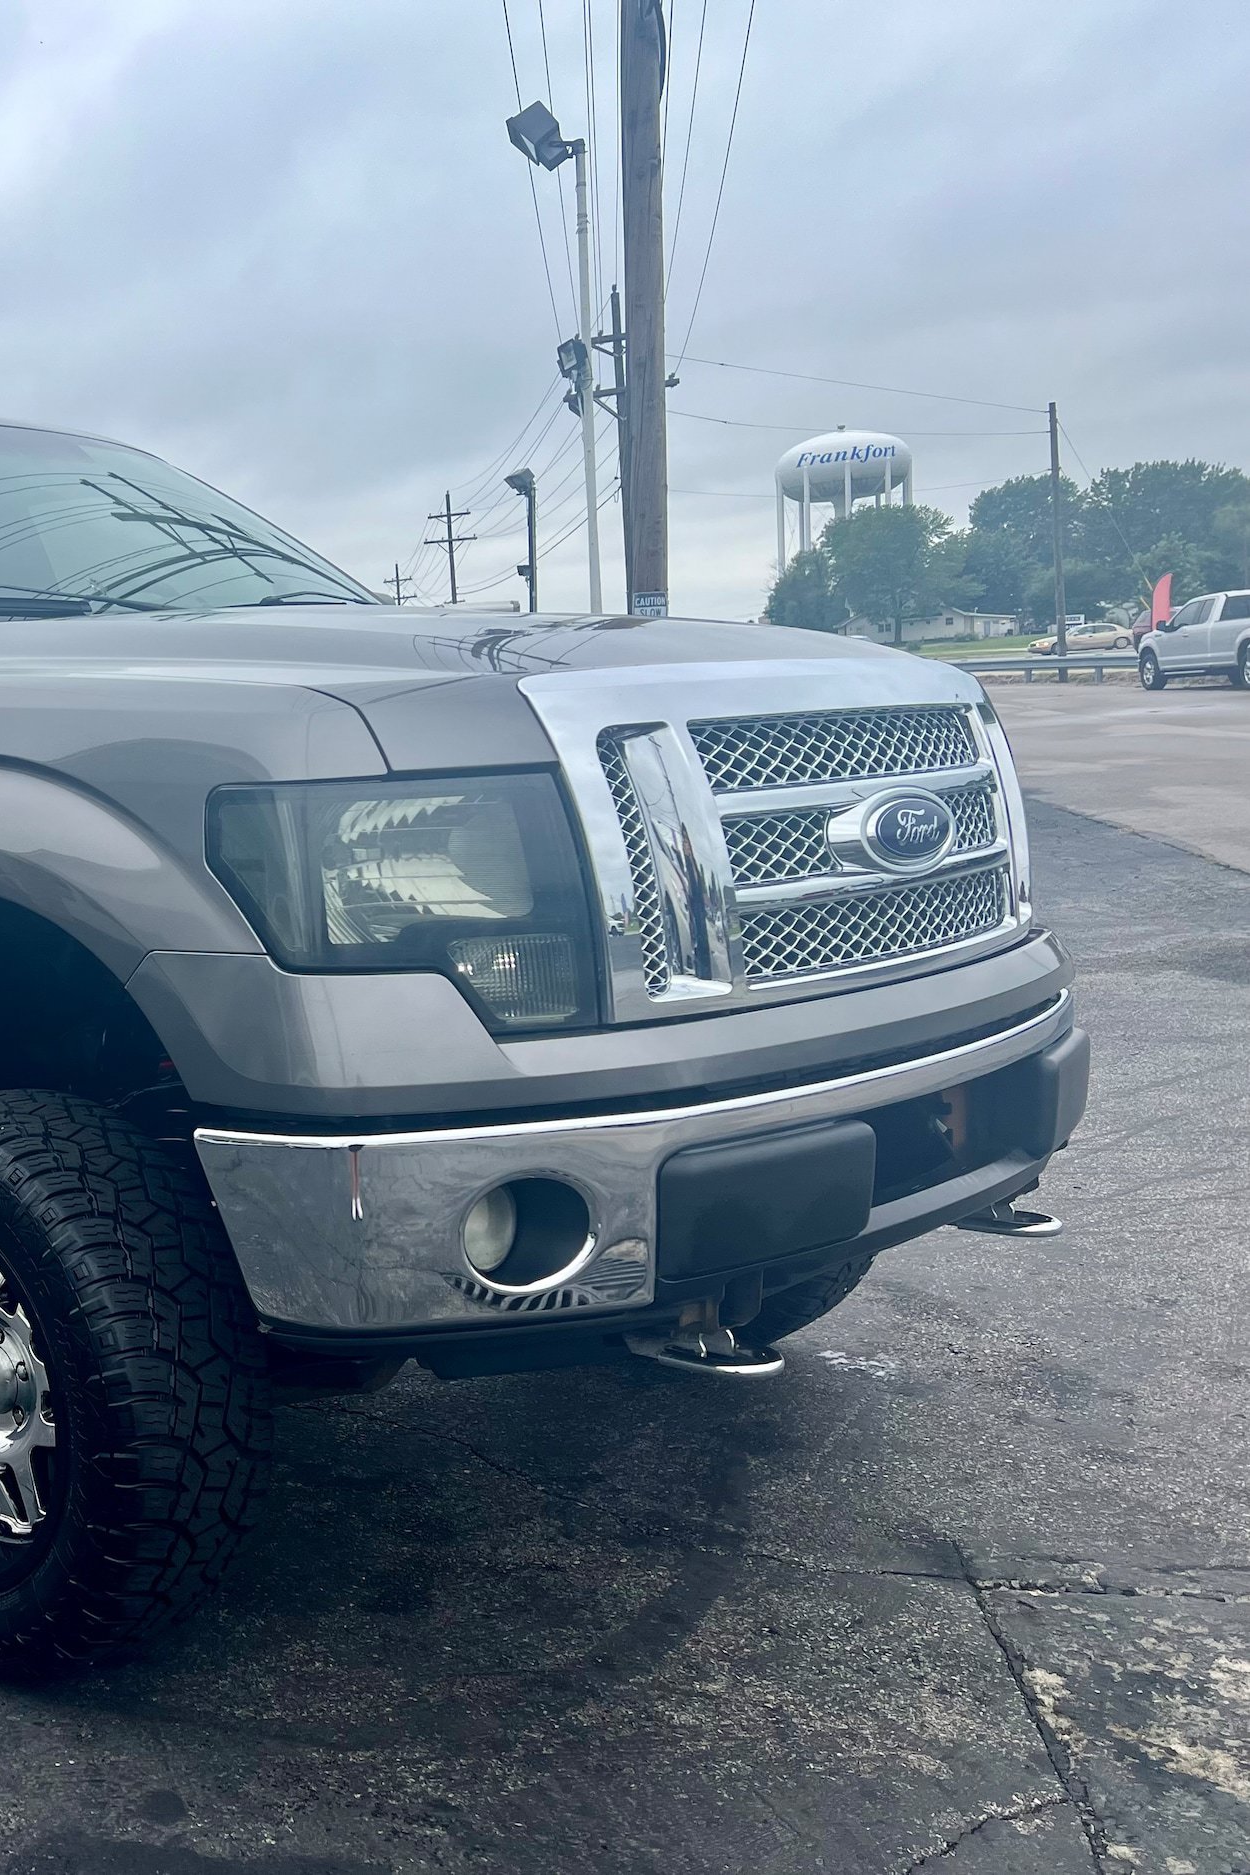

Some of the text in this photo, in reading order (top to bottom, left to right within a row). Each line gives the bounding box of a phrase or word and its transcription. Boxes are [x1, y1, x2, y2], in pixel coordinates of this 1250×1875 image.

[797, 444, 896, 467] Frankfort
[635, 596, 666, 607] CAUTION
[897, 809, 940, 843] Ford
